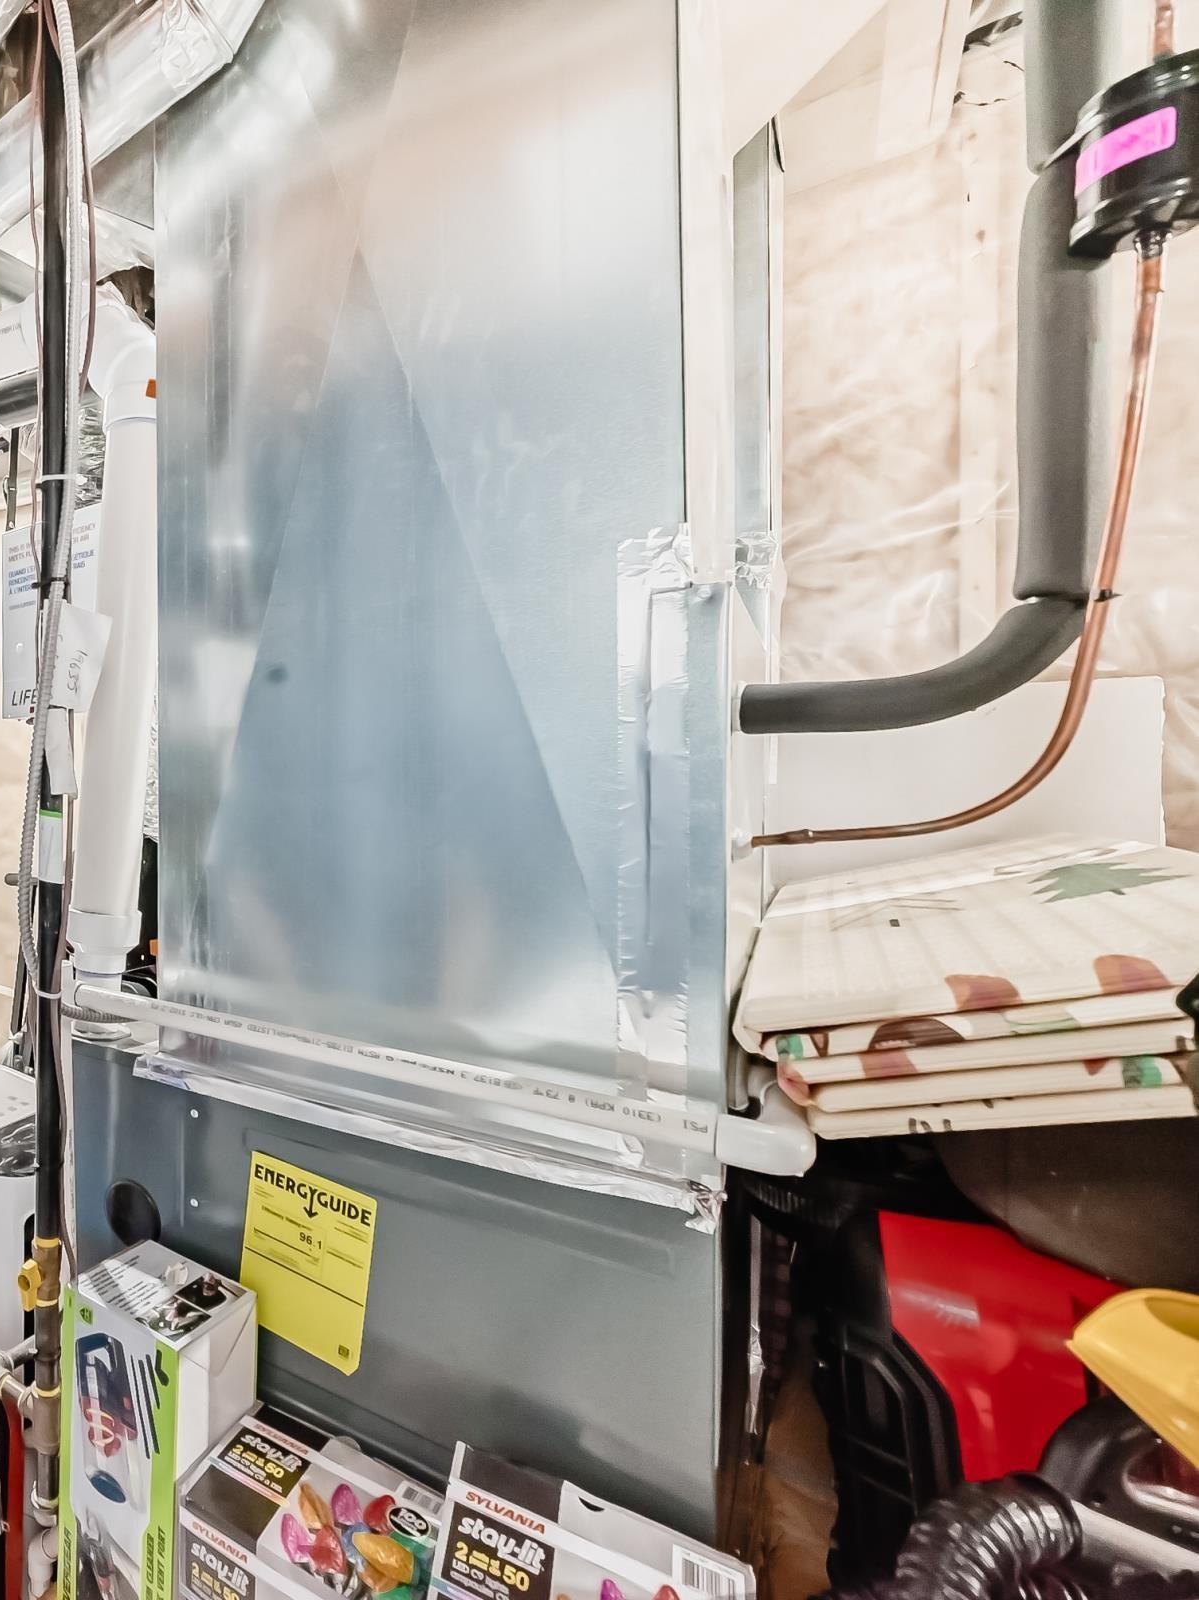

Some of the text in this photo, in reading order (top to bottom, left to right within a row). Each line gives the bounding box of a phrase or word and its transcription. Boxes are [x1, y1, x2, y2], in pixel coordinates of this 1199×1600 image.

[683, 1119, 708, 1133] PSI
[254, 1163, 373, 1228] ENERGYGUIDE
[465, 1491, 545, 1535] SYLVANIA
[192, 1521, 249, 1564] SYLVANIA
[455, 1541, 530, 1592] 2 50
[458, 1516, 545, 1576] stay-lit
[191, 1543, 249, 1597] stay-lit
